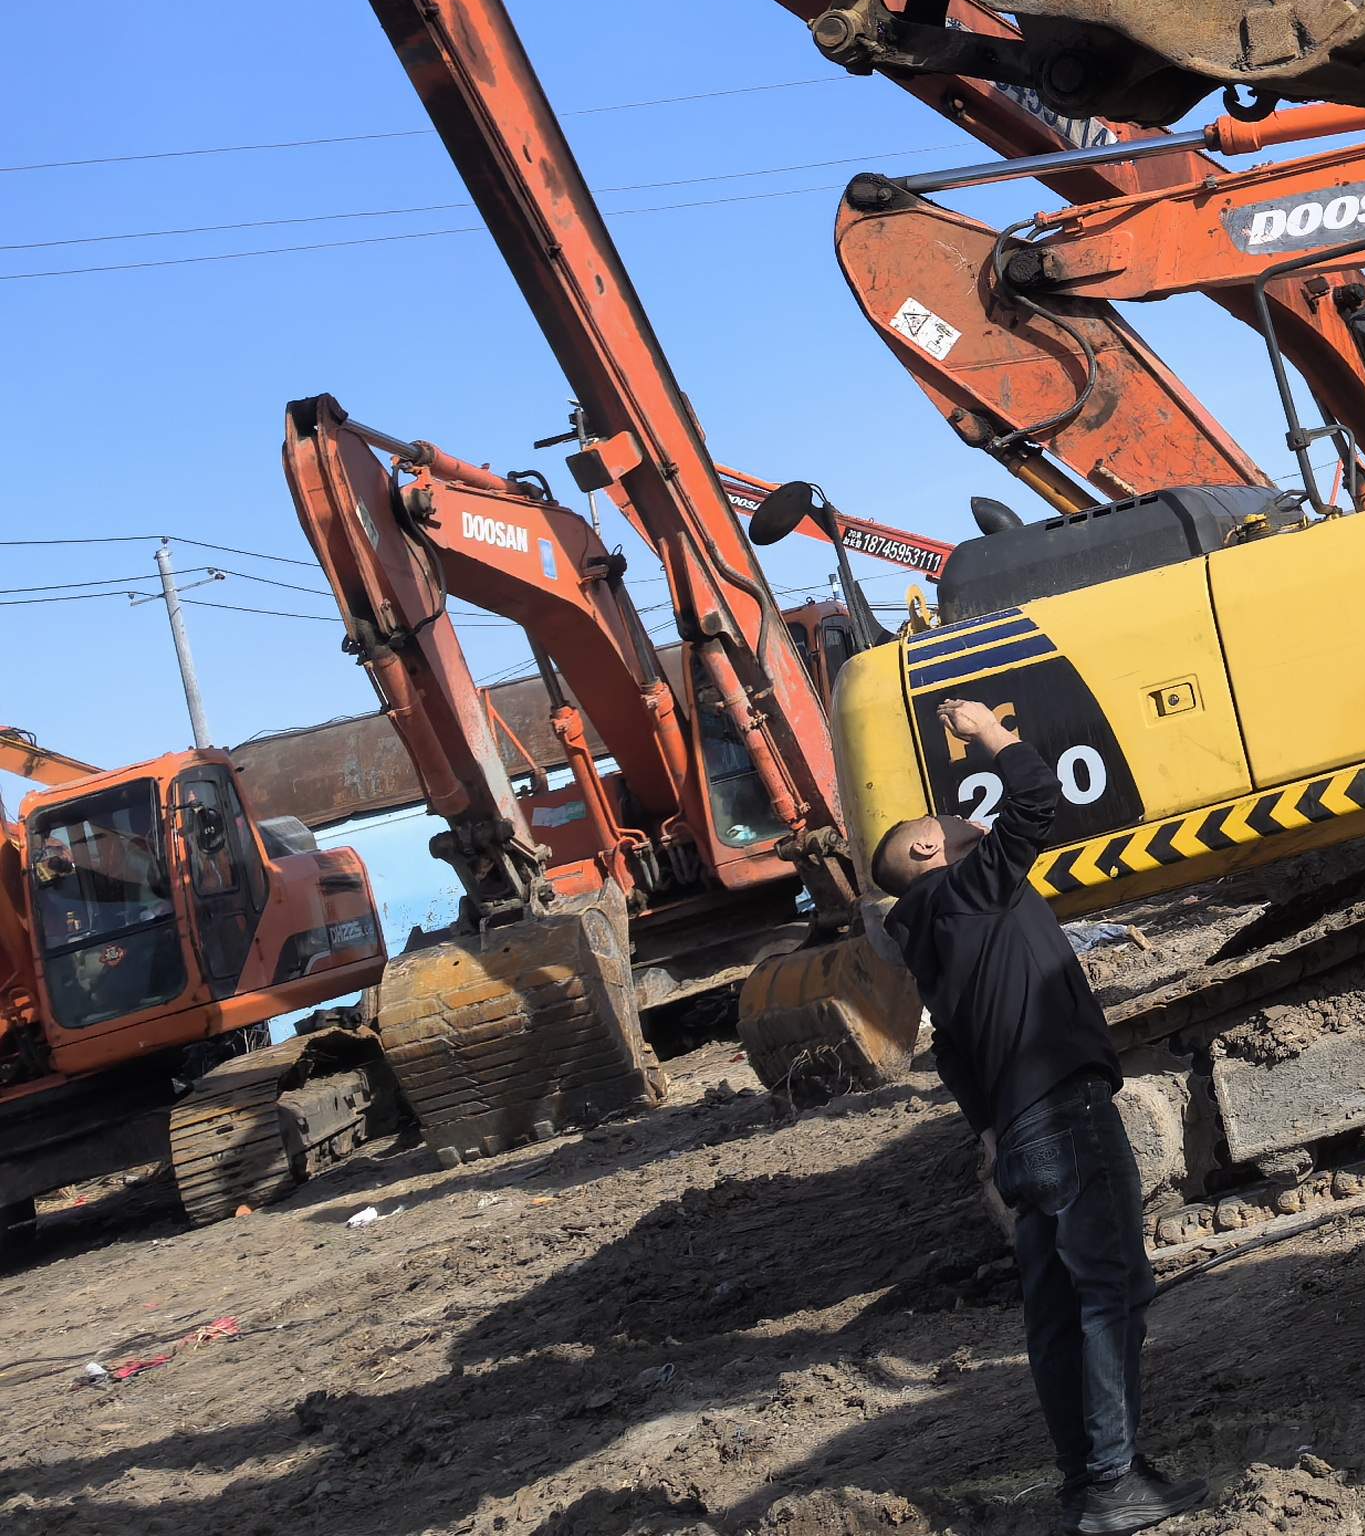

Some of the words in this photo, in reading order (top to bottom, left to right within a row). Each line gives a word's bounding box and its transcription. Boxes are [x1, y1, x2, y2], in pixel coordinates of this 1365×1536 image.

[462, 511, 528, 553] DOOSAN
[863, 533, 942, 572] 18745953111
[958, 771, 1107, 828] 20
